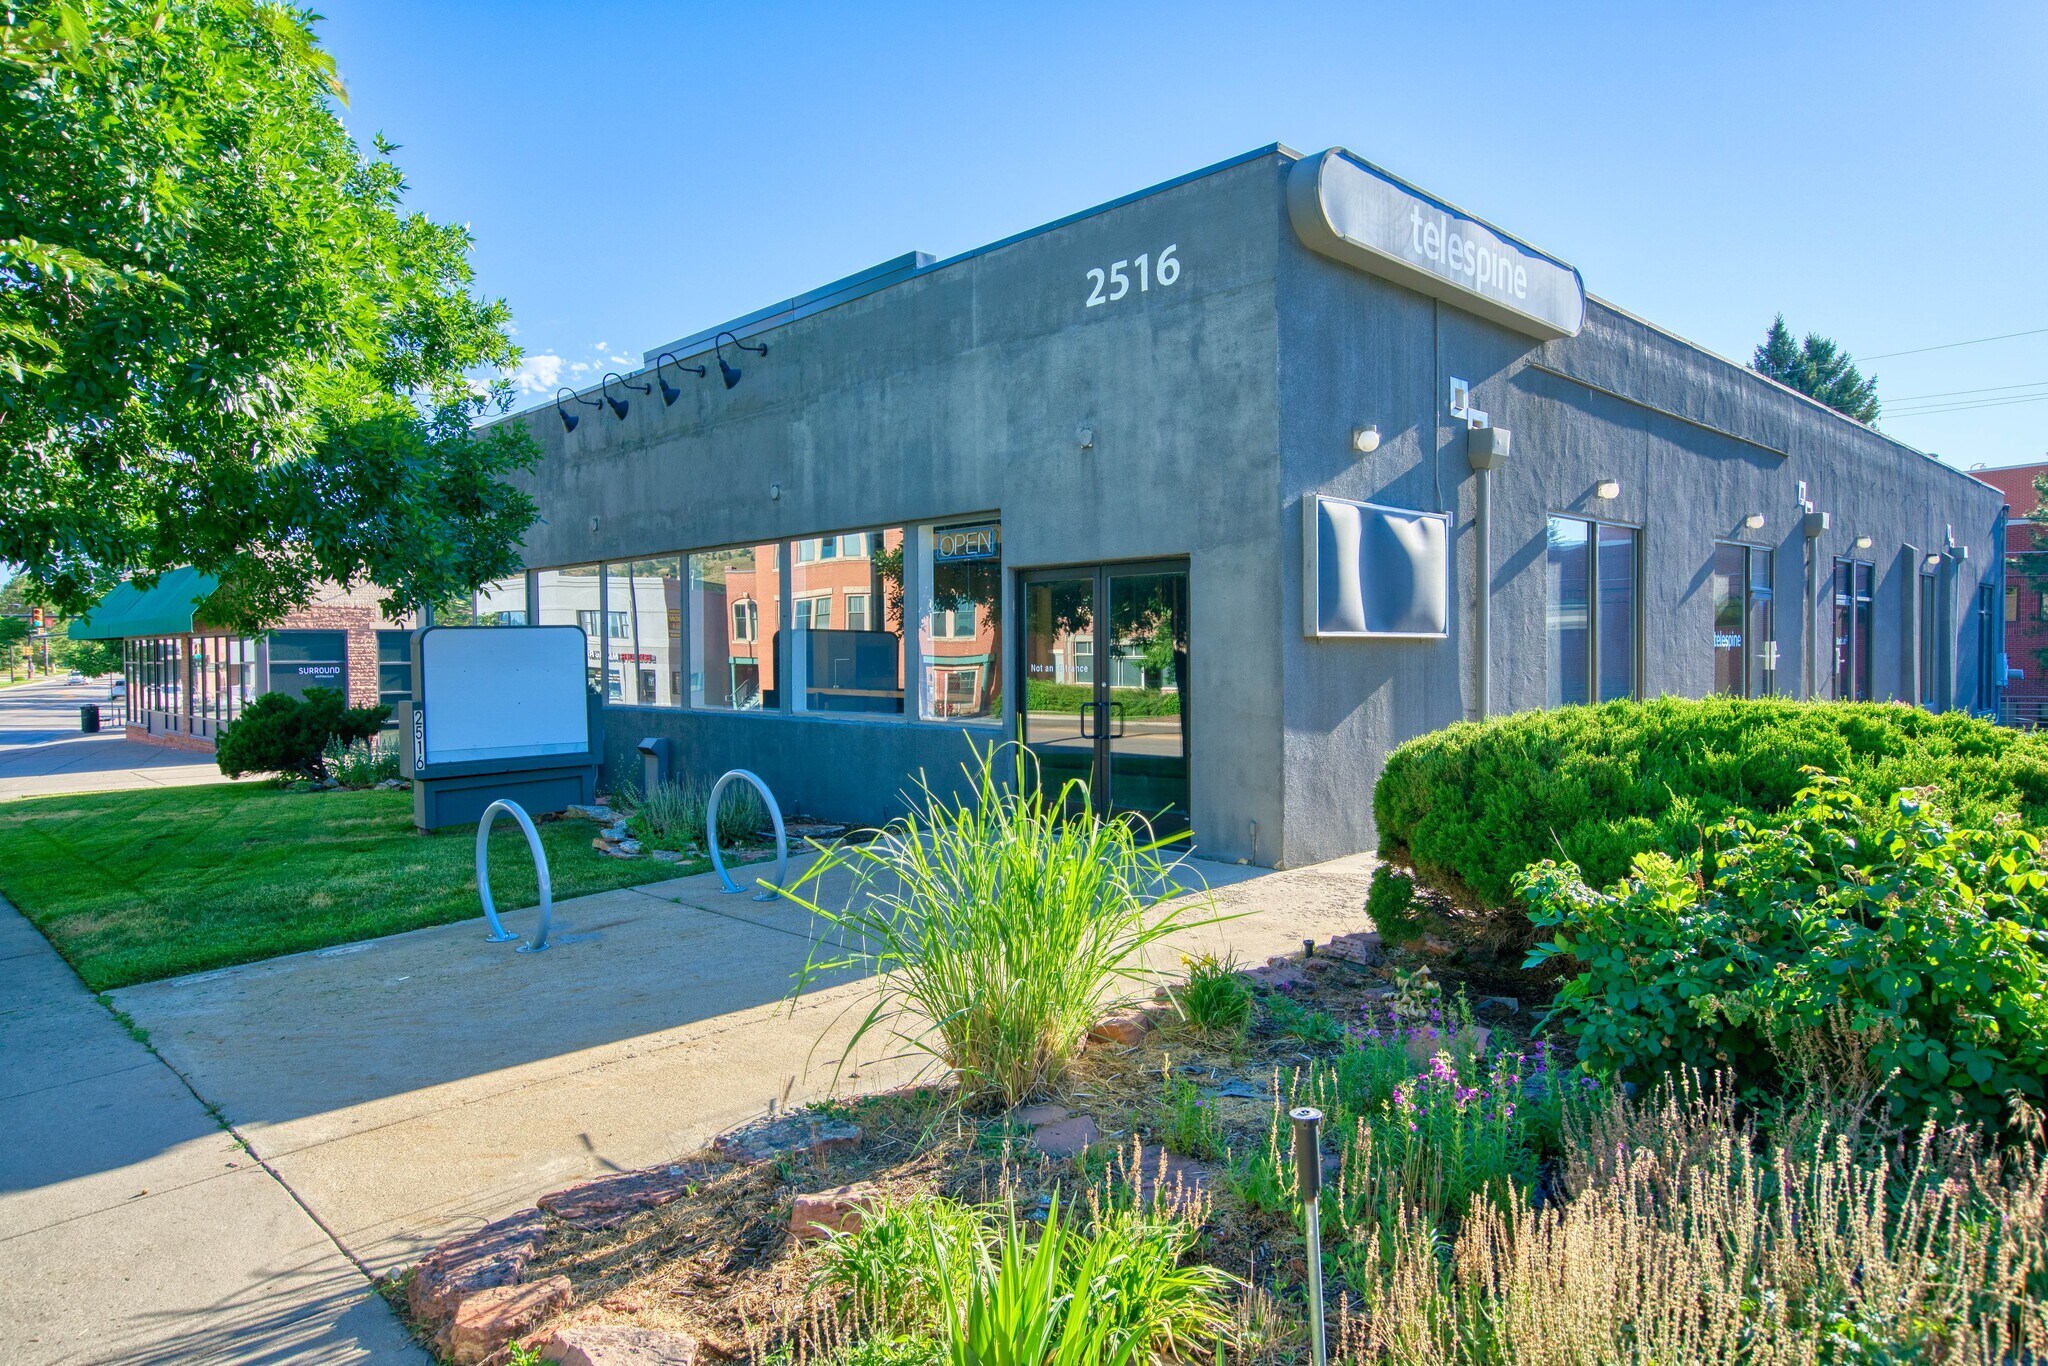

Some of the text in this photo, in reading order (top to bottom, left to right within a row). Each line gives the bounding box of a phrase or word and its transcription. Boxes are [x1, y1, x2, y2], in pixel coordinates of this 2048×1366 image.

[1410, 204, 1527, 299] telespine
[1086, 244, 1180, 307] 2516
[940, 531, 992, 557] OPEN
[1714, 631, 1742, 651] telespine
[1031, 664, 1043, 672] Not
[414, 710, 424, 770] 2516
